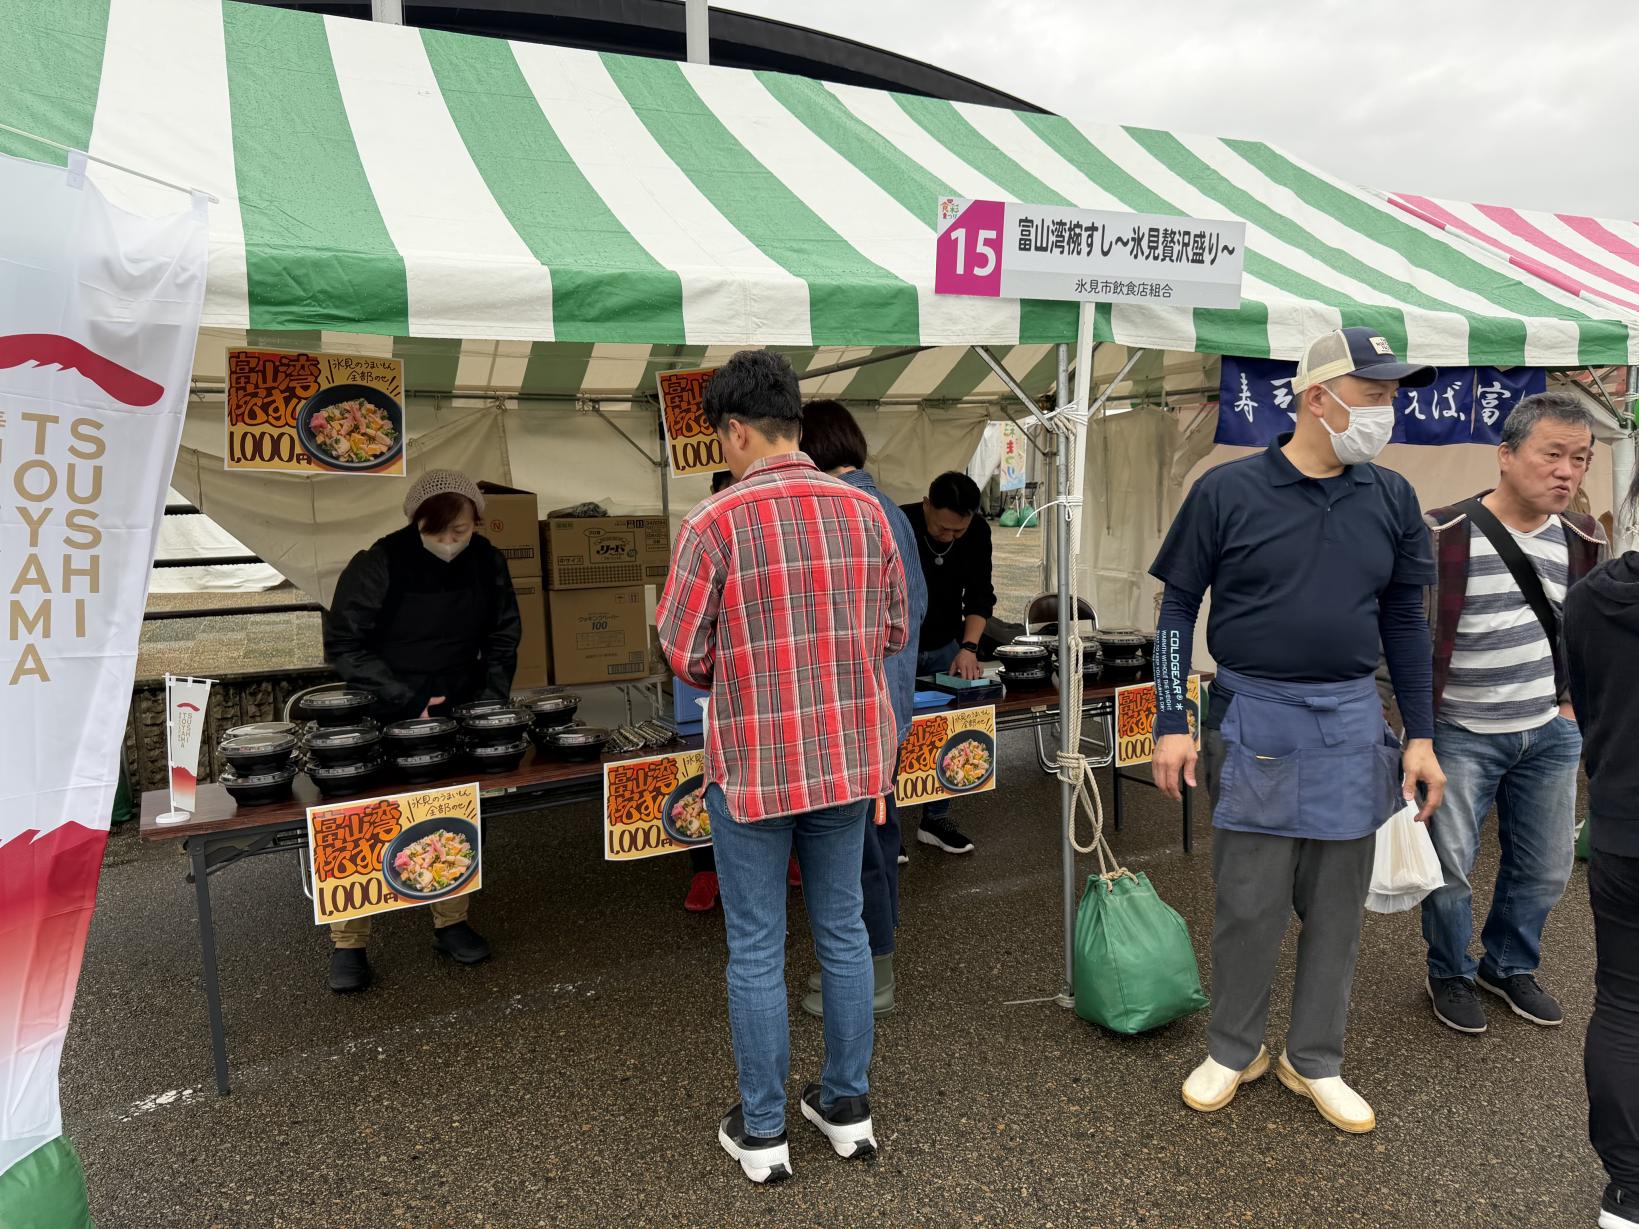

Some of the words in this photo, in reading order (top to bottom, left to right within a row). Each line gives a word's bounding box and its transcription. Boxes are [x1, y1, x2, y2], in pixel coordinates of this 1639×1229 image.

[950, 227, 997, 276] 15
[1075, 278, 1174, 298] 氷見市飲食店組合
[229, 351, 321, 398] 富山湾
[229, 431, 312, 466] 1,000円
[672, 438, 728, 471] 1,000
[62, 417, 106, 638] SUSHI
[9, 412, 59, 685] TOYAMA
[608, 757, 680, 796] 富山湾
[313, 800, 403, 846] 富山湾
[609, 825, 673, 854] 1,000円
[319, 877, 399, 917] 1,000円
